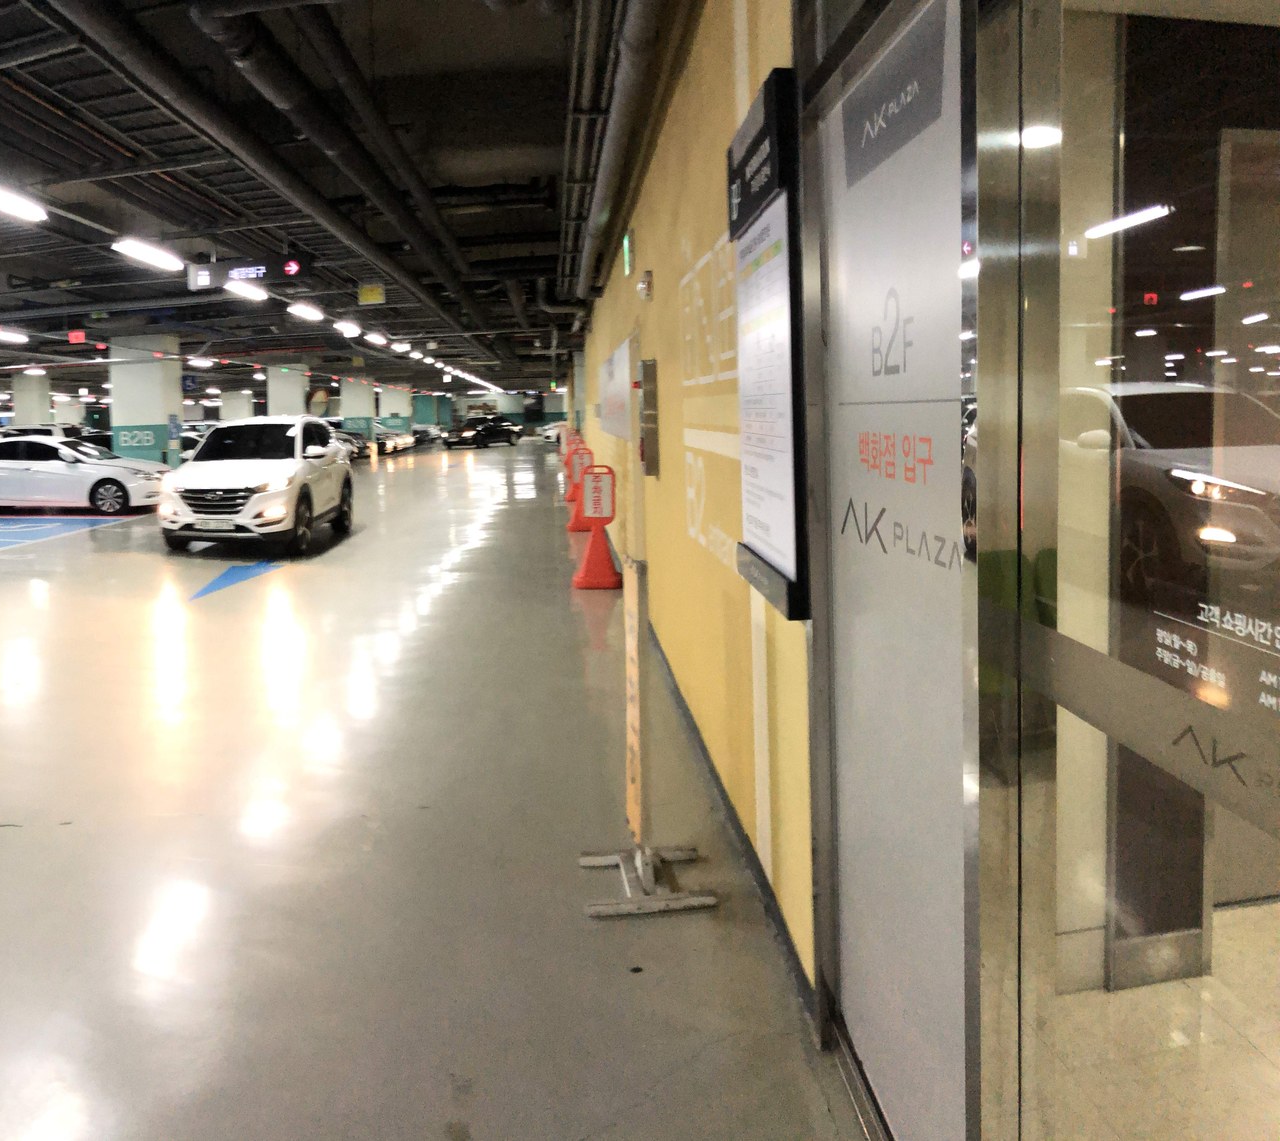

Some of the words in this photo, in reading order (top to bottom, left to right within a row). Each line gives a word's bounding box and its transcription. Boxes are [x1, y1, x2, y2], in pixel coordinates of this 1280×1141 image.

[861, 102, 887, 149] AK
[871, 286, 915, 378] B2F
[118, 430, 156, 448] B2B
[858, 430, 897, 480] 백화점
[901, 432, 935, 486] 입구
[841, 497, 889, 555] AK
[892, 521, 962, 574] PLAZA
[1196, 601, 1221, 629] 고객
[1221, 609, 1273, 647] 쇼핑시간
[1171, 724, 1248, 788] AK
